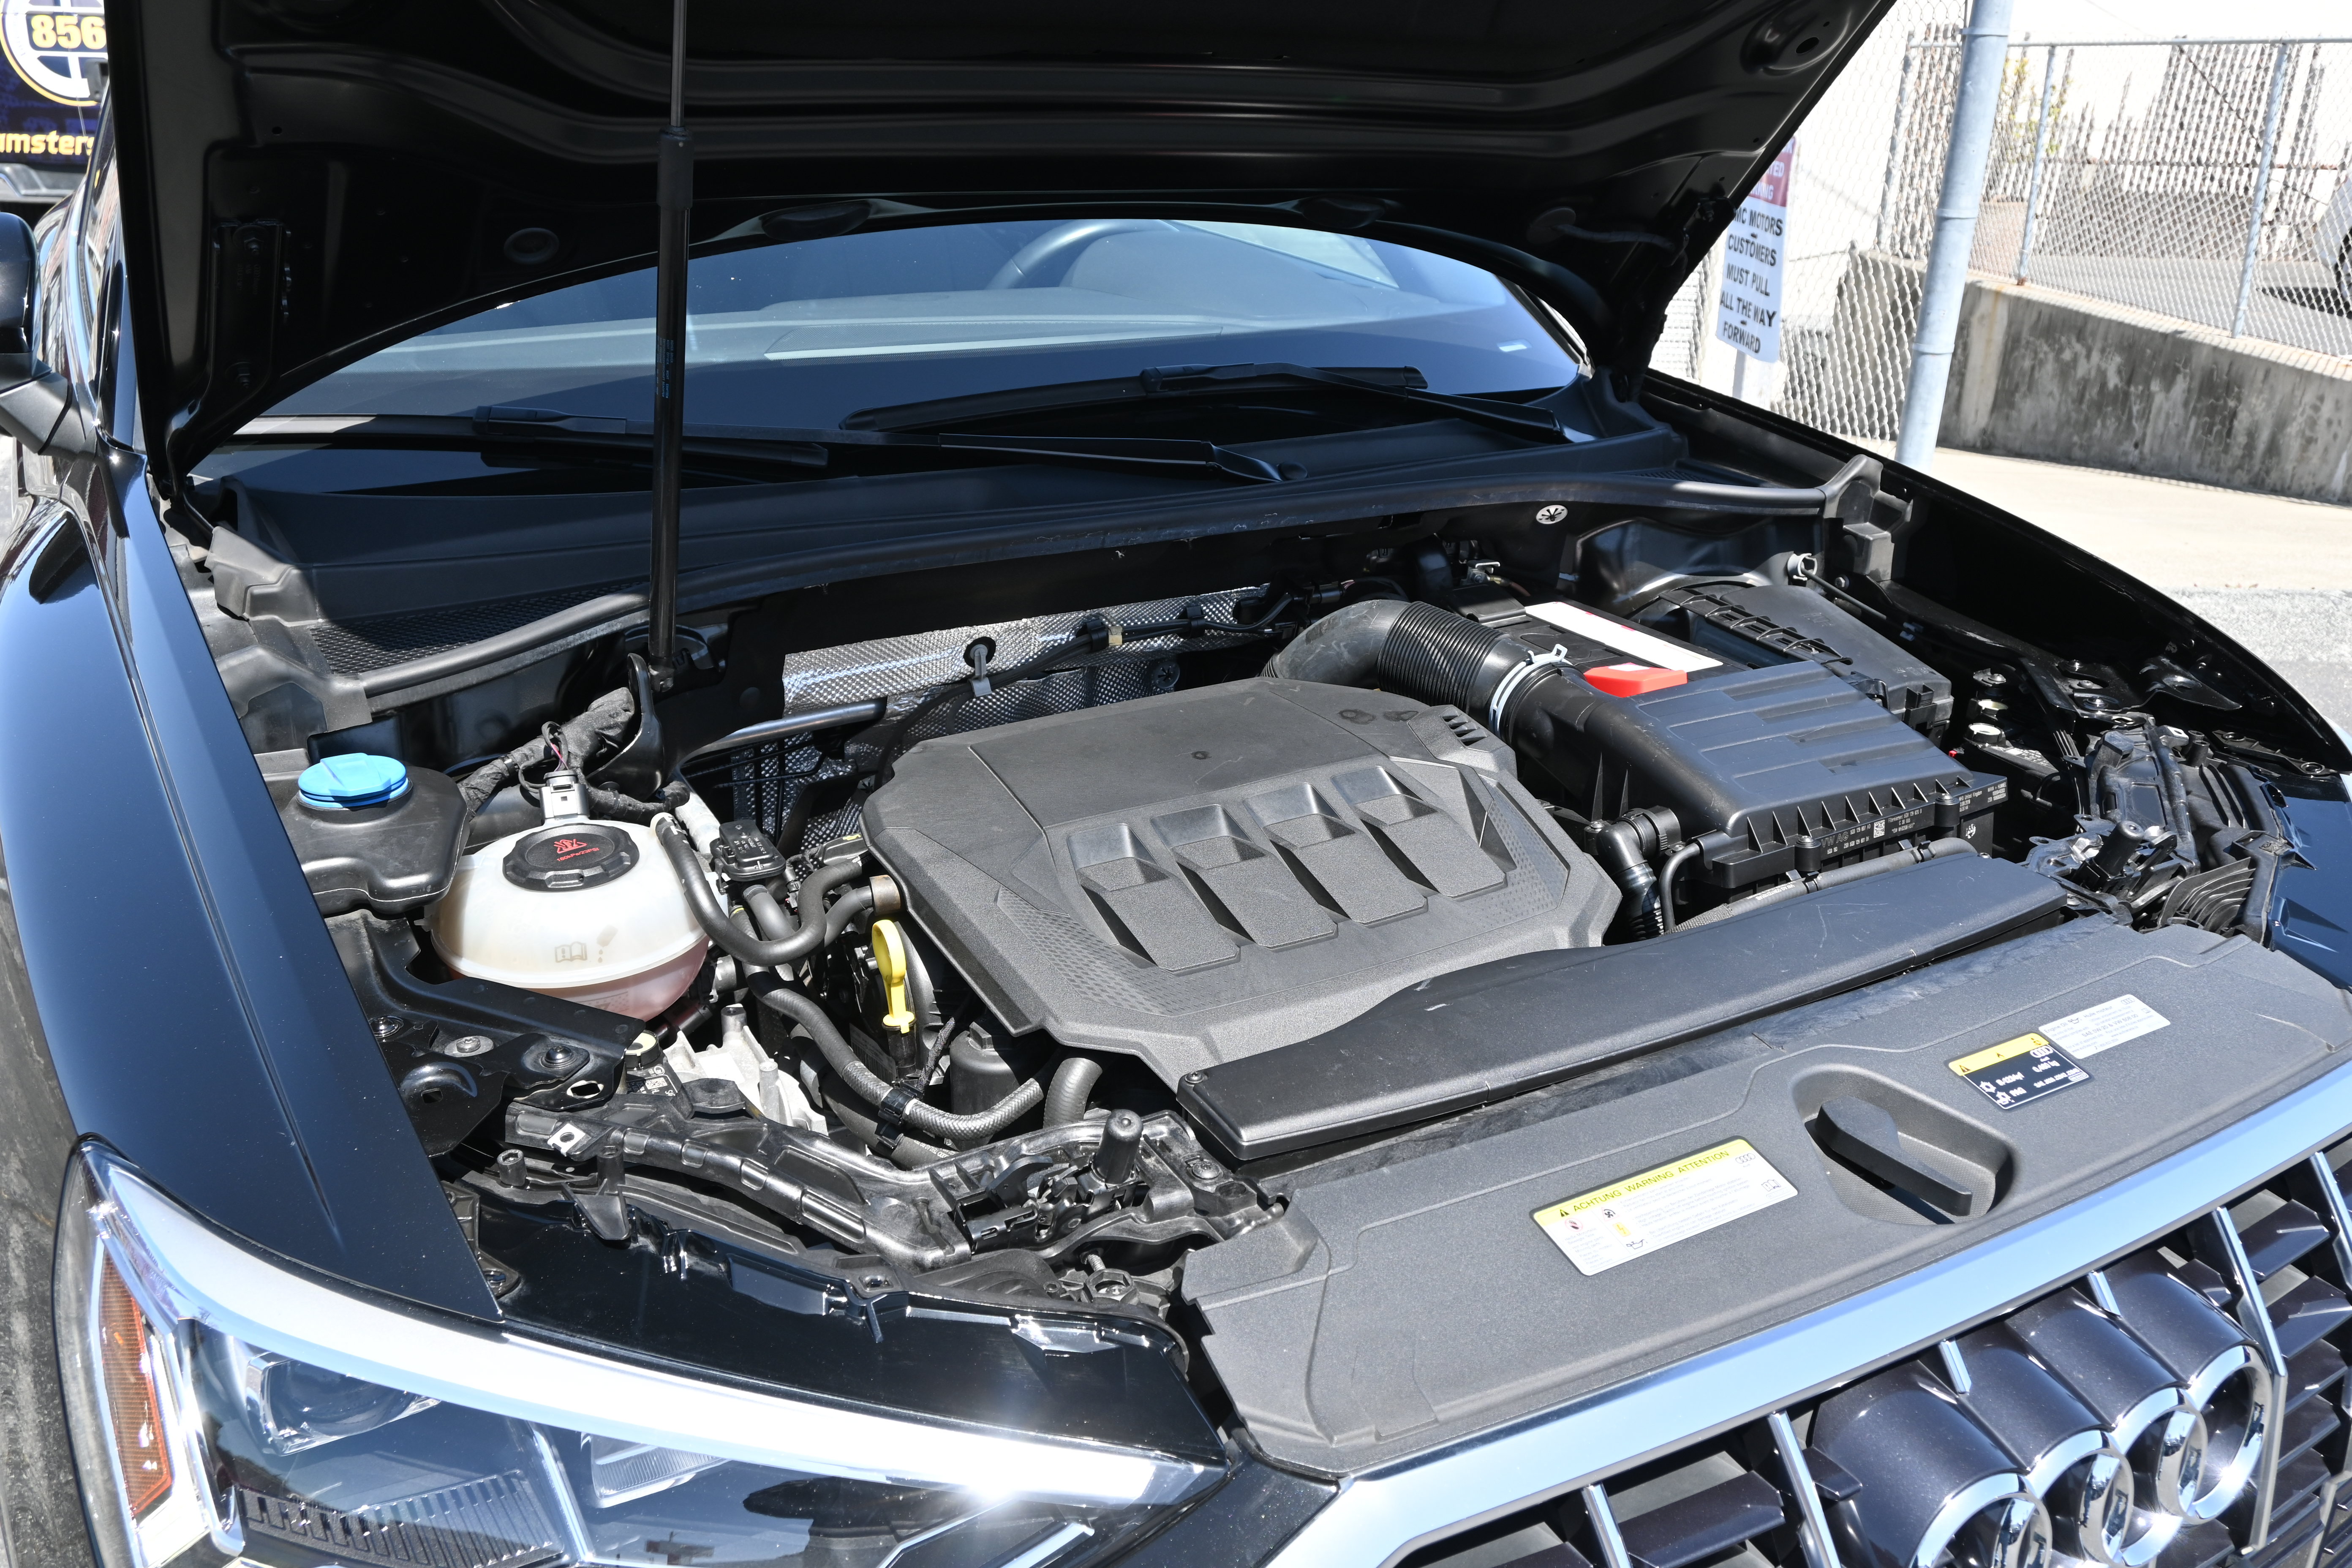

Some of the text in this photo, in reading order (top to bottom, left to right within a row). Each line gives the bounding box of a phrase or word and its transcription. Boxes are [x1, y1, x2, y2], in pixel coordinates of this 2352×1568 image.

[1749, 209, 1783, 236] MOTORS
[1728, 235, 1777, 266] CUSTOMERS
[1726, 263, 1770, 297] MUST PULL
[1720, 291, 1777, 327] ALL THE WAY
[1723, 321, 1761, 354] FORWARD
[1821, 832, 1848, 848] VW AG
[1572, 1151, 1729, 1211] ACHTUNG WARNING ATTENTION
